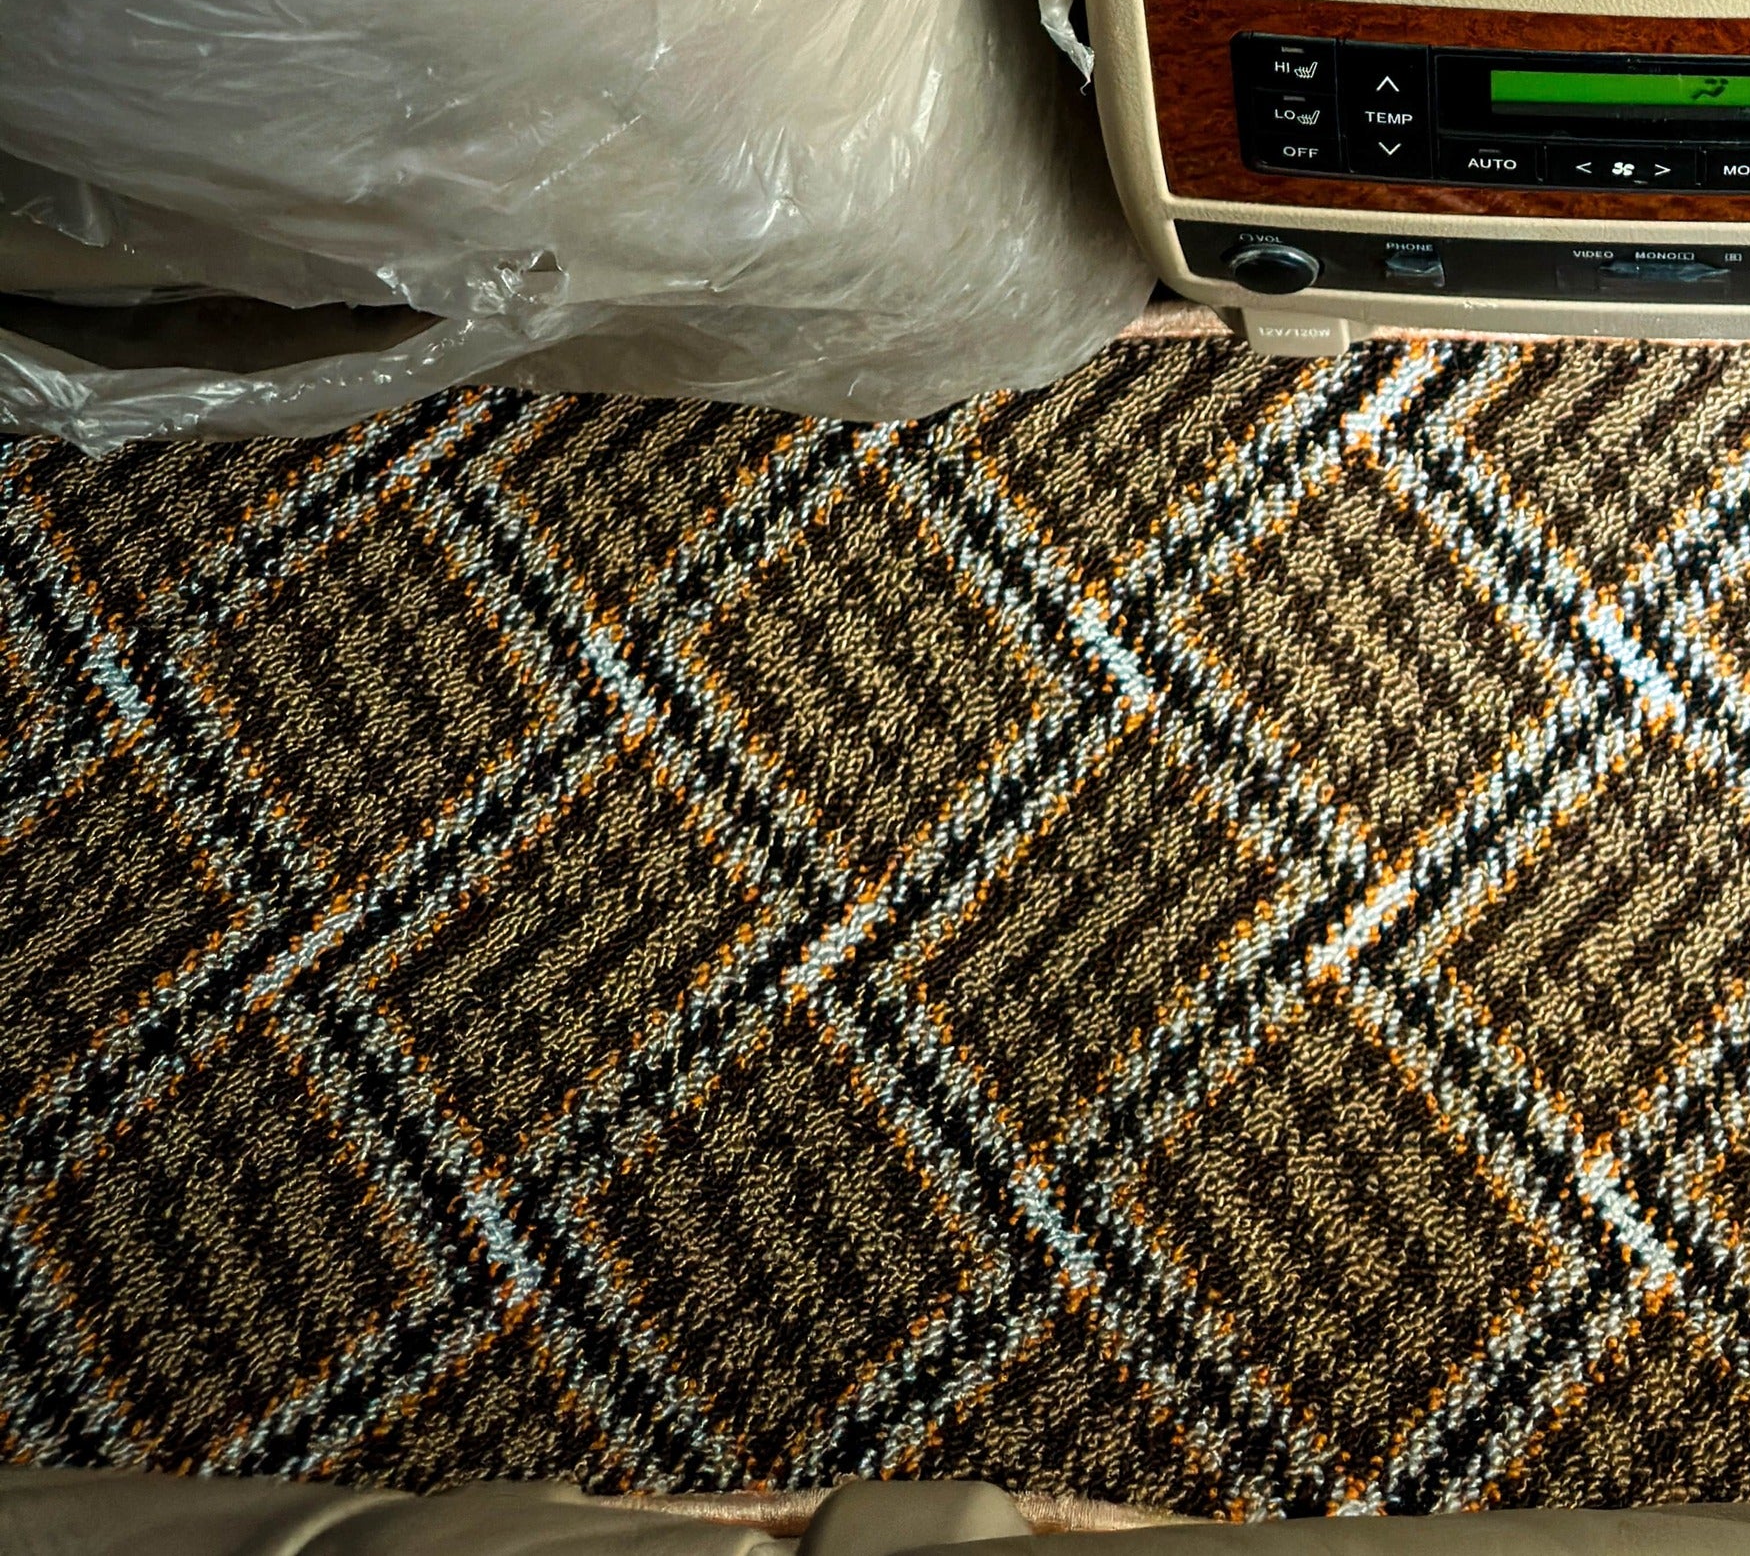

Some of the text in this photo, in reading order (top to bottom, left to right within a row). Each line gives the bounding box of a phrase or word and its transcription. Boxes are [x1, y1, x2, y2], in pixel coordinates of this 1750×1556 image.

[1274, 60, 1291, 74] HI
[1274, 108, 1296, 121] LO
[1364, 110, 1414, 126] TEMP
[1282, 145, 1320, 159] OFF
[1467, 156, 1518, 172] AUTO
[1255, 233, 1284, 244] VOL
[1385, 241, 1435, 253] PHONE
[1572, 249, 1615, 260] VIDEO
[1258, 326, 1332, 338] 12V/120W
